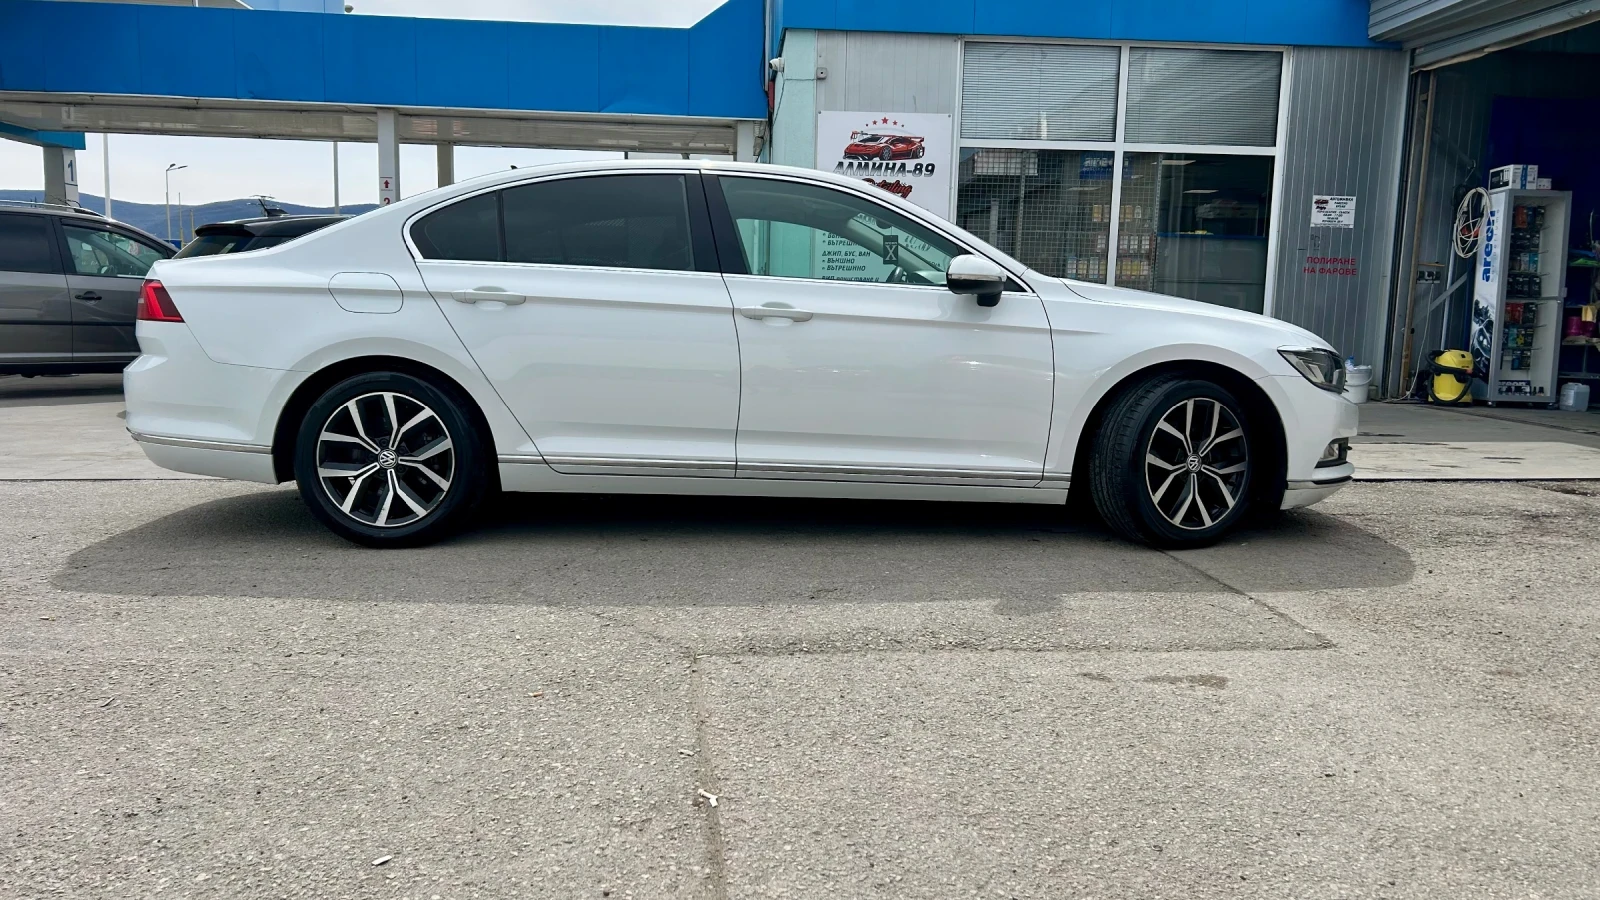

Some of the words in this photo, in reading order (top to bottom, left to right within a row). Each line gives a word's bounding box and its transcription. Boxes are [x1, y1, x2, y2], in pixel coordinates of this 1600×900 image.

[68, 160, 74, 181] 1
[833, 161, 936, 177] АЛМИНА-89
[1306, 256, 1356, 266] ПОЛИРАНЕ
[1303, 266, 1316, 274] НА
[1318, 267, 1357, 276] ФАРОВЕ
